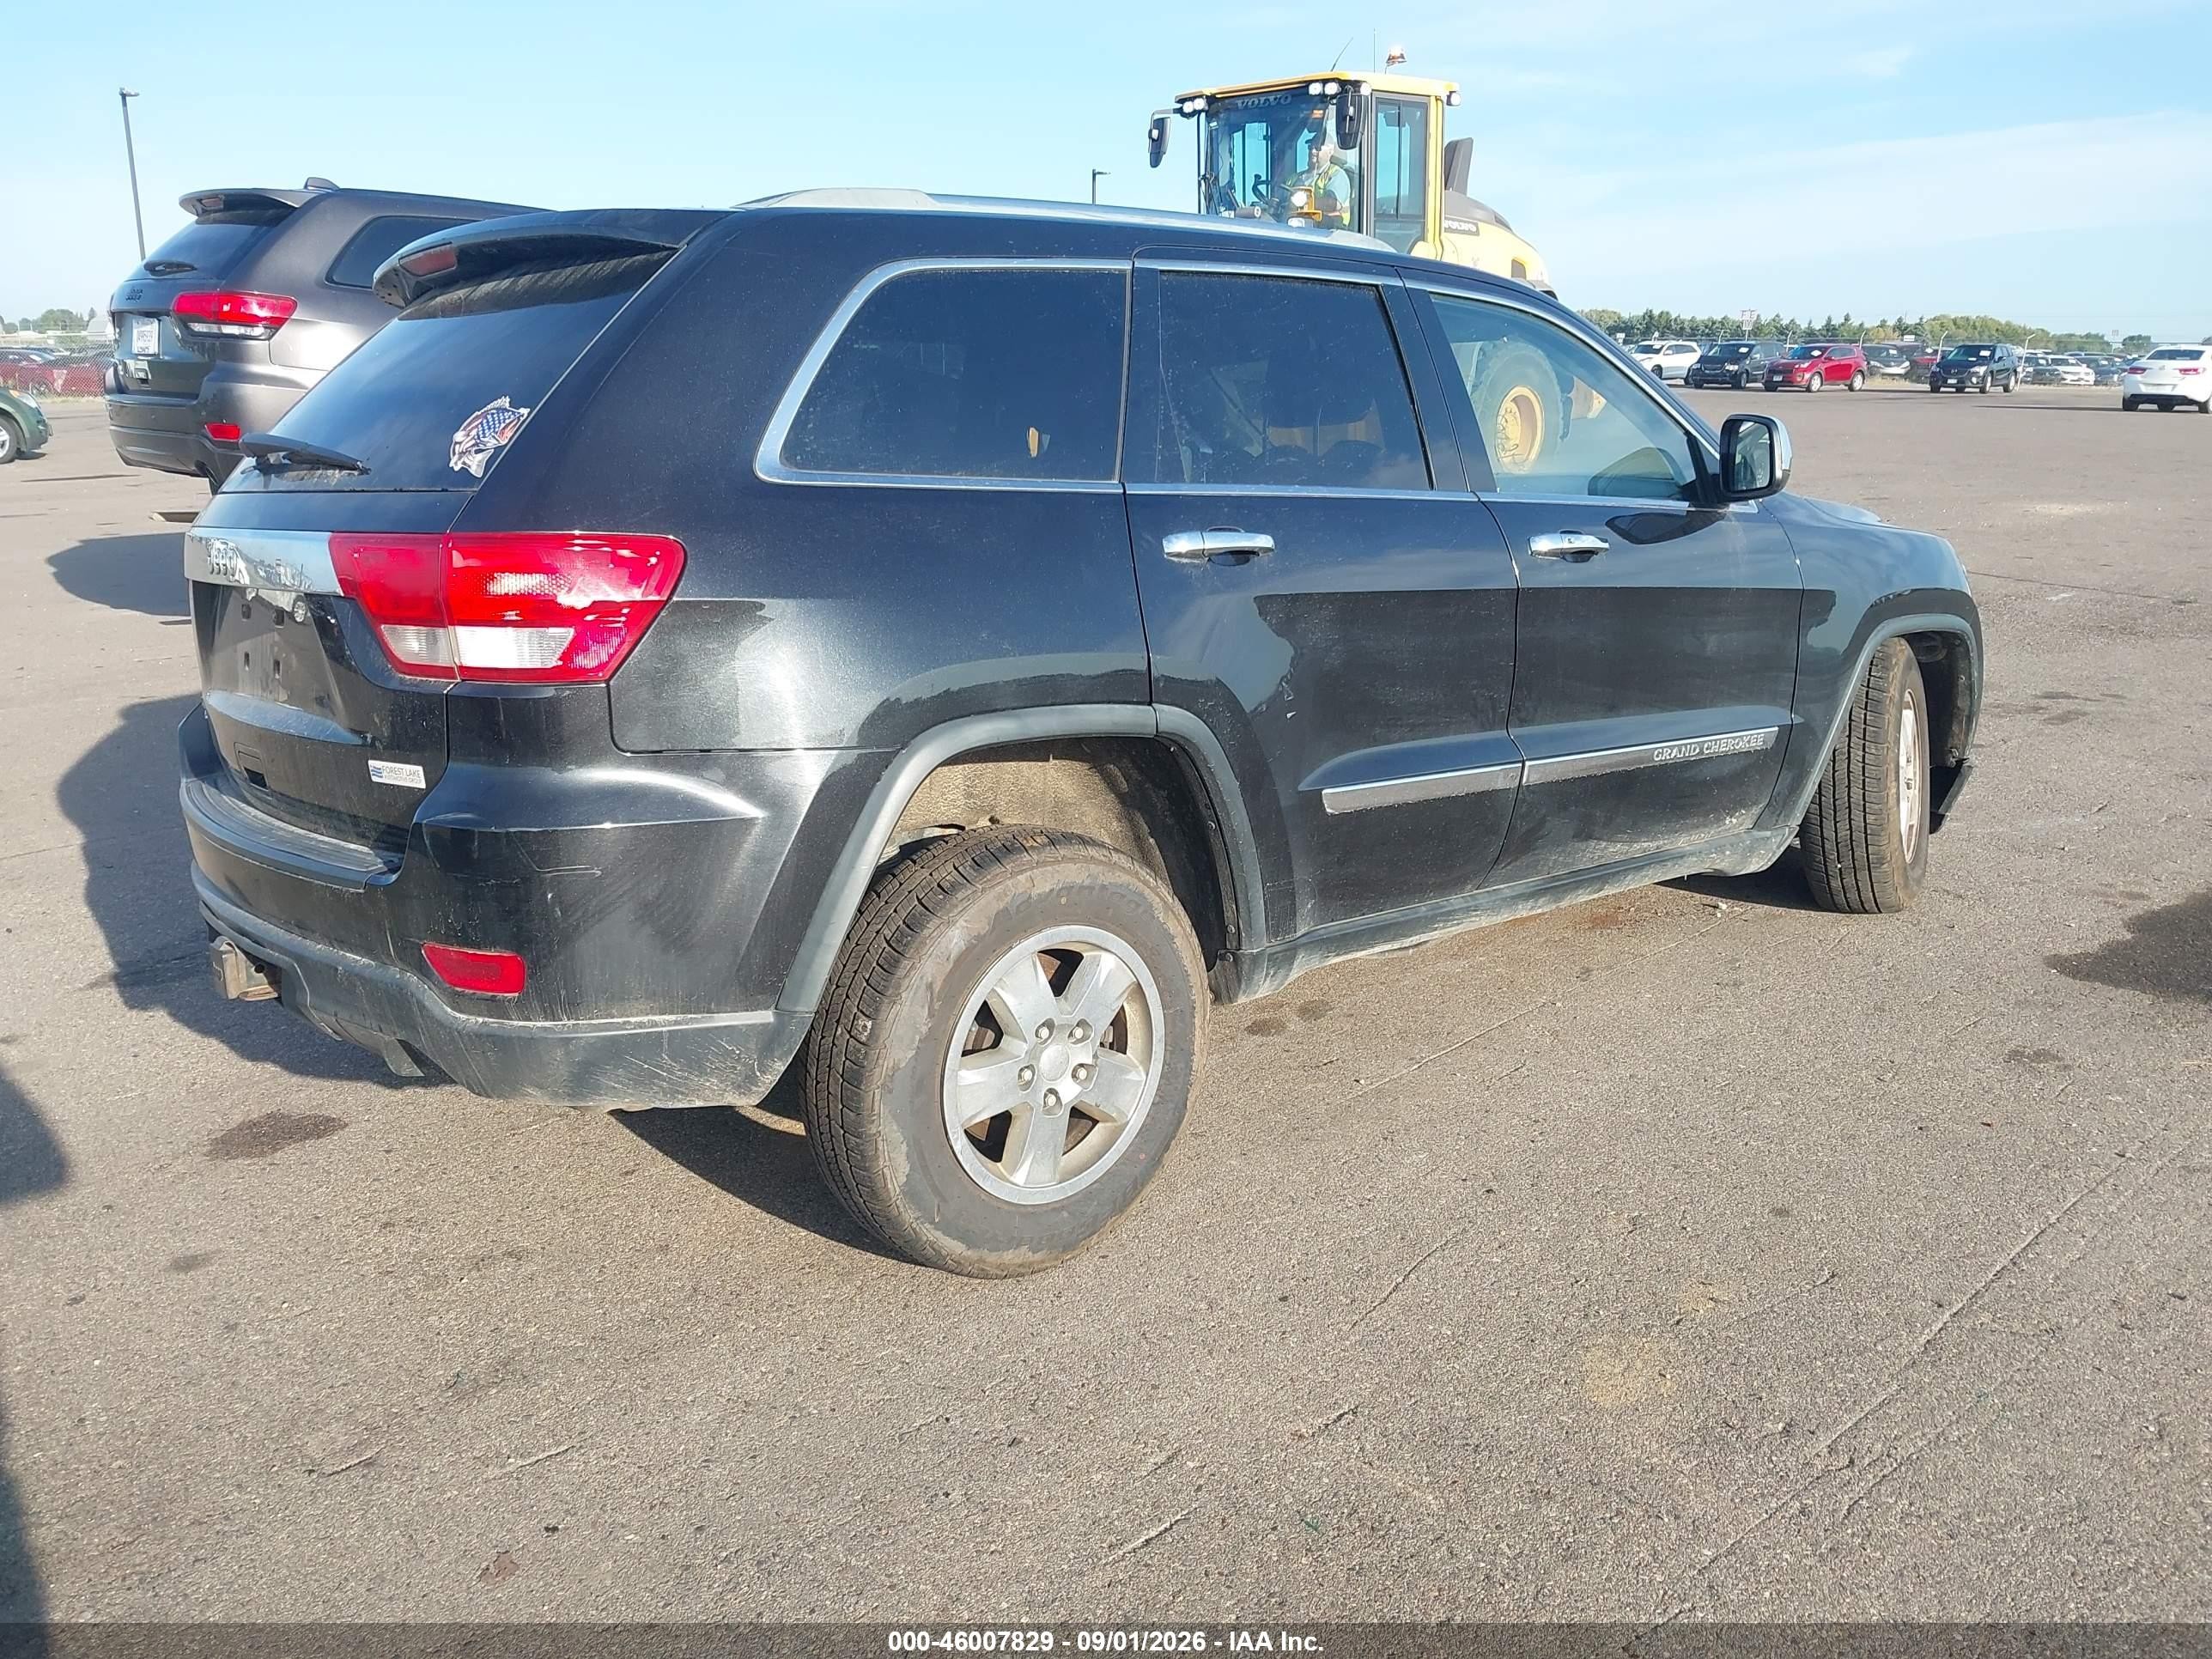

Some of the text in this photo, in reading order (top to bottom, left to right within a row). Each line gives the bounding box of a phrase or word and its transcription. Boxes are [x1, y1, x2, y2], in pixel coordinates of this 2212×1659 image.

[1236, 94, 1291, 110] VOLVO
[1653, 733, 1765, 761] GRAND CHEROKEE
[381, 765, 422, 779] FOREST LAKE
